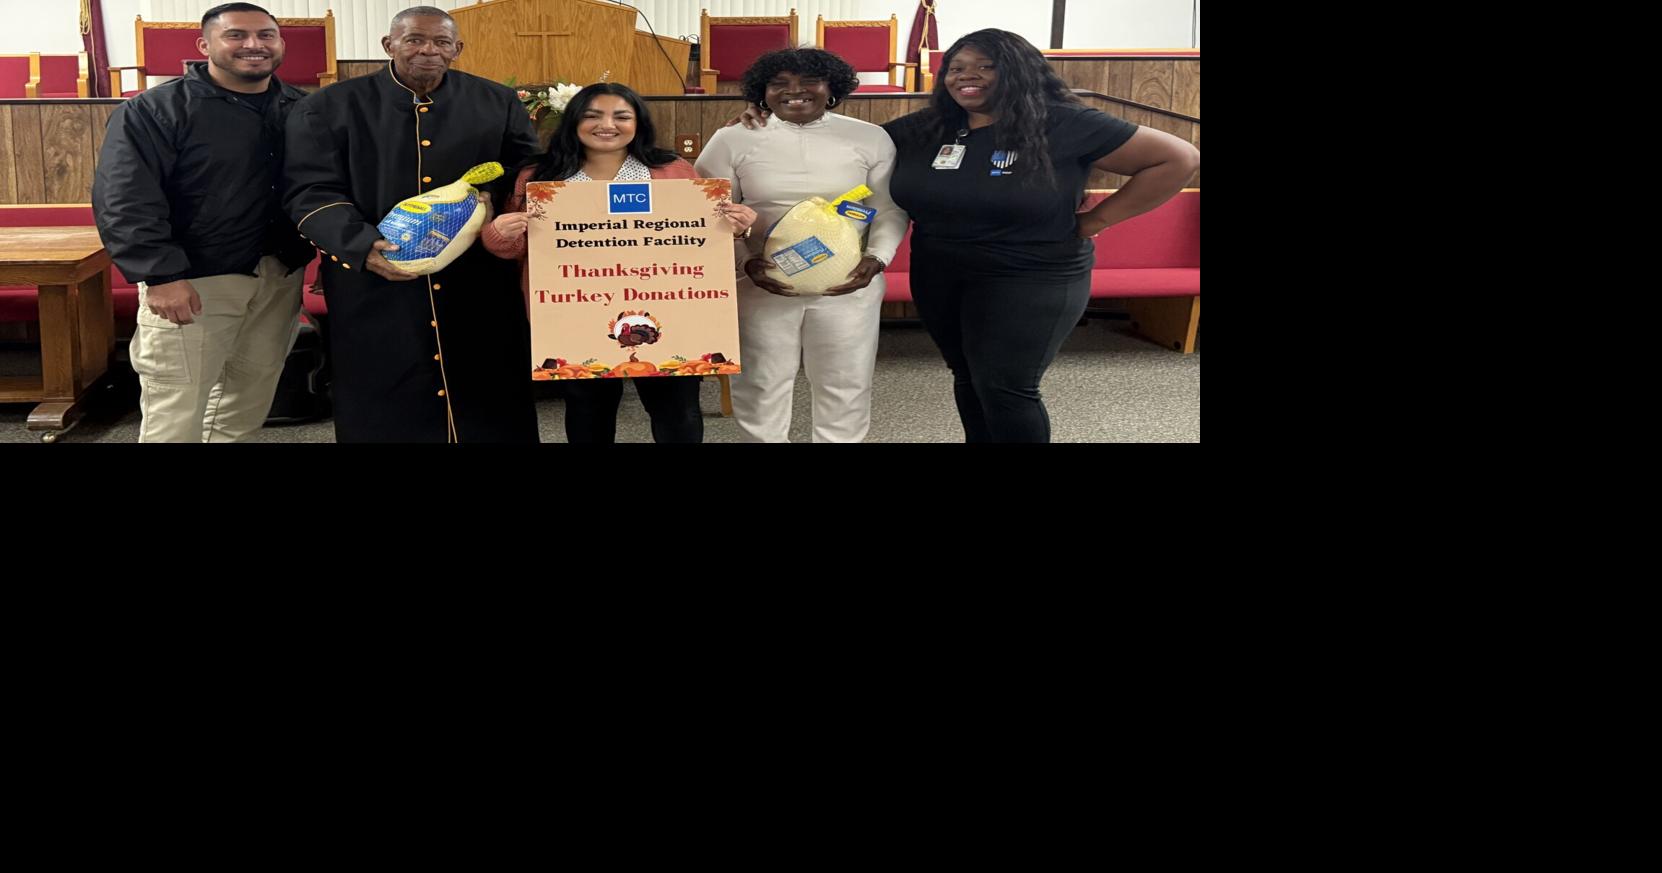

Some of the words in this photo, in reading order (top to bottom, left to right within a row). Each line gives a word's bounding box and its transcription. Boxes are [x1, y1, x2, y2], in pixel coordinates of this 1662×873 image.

[613, 193, 646, 203] MTC
[555, 219, 628, 232] Imperial
[634, 218, 706, 231] Regional
[557, 237, 638, 248] Detention
[644, 235, 706, 247] Facility
[558, 263, 704, 280] Thanksgiving
[534, 288, 615, 306] Turkey
[624, 287, 729, 301] Donations
